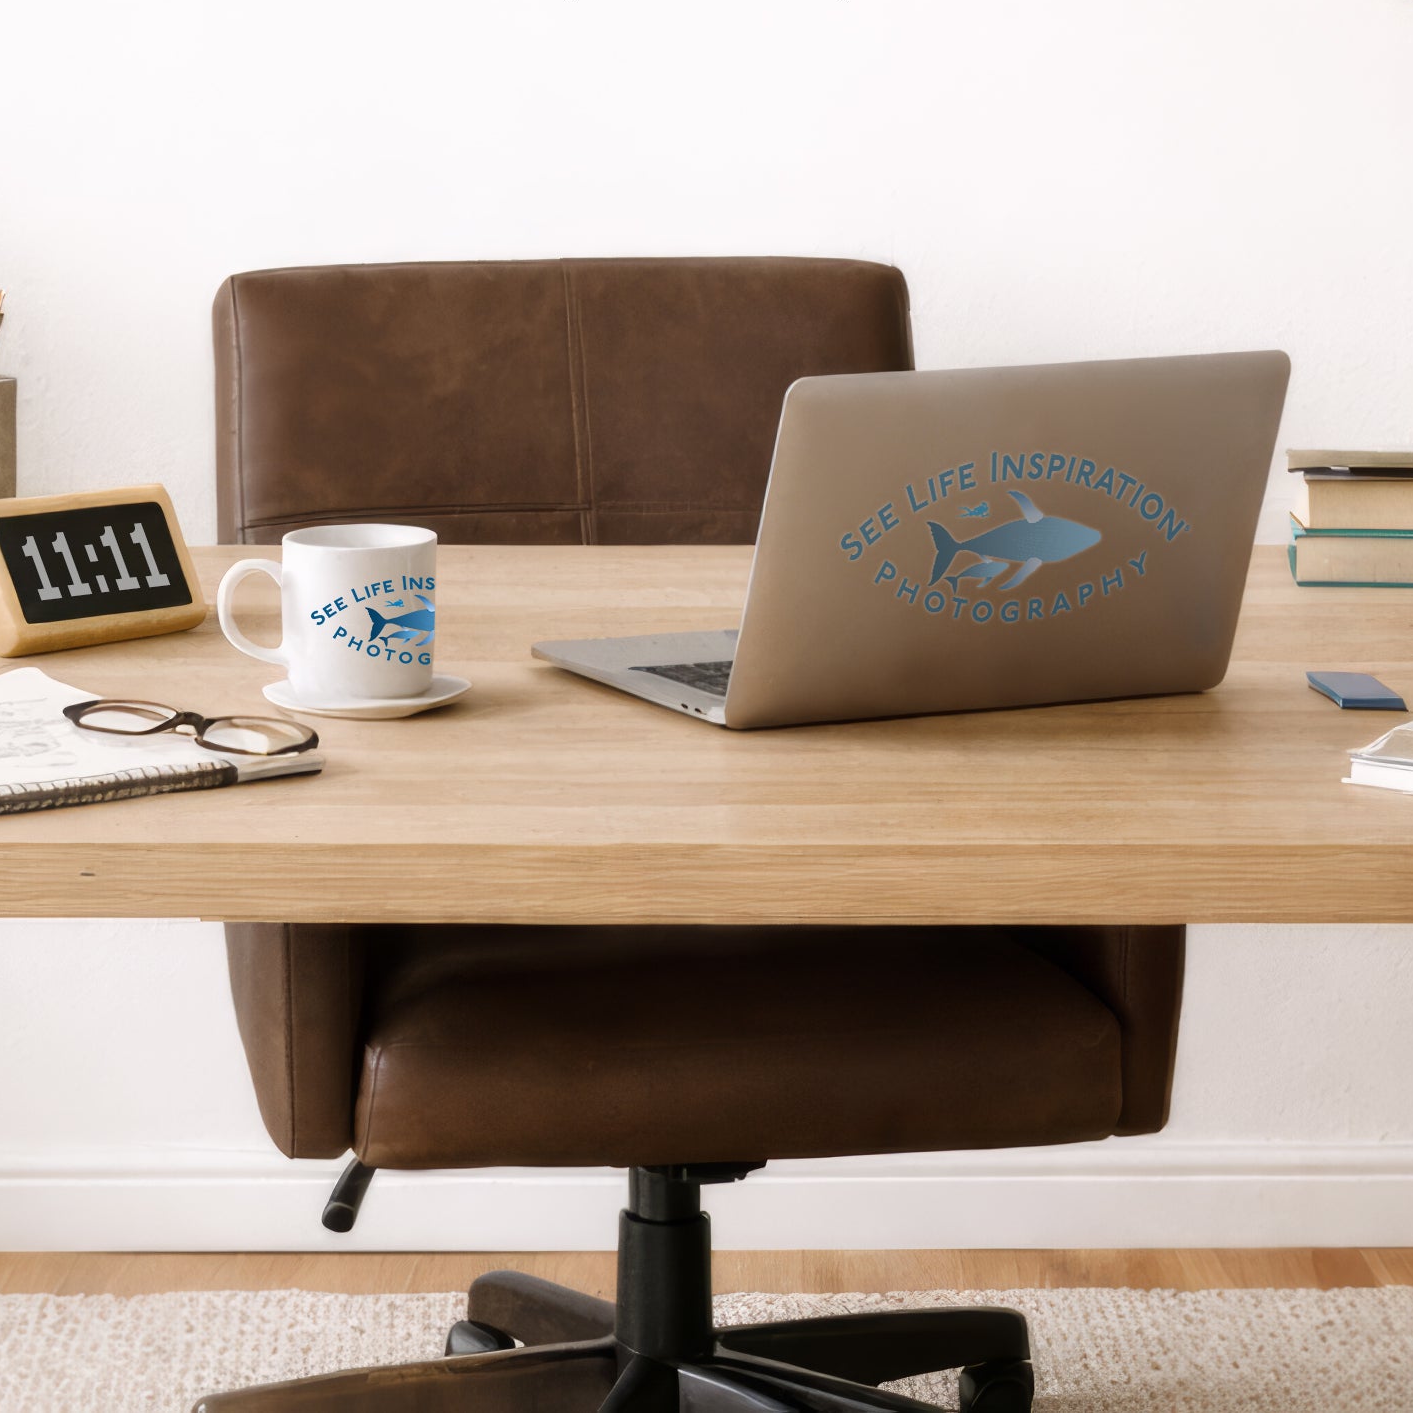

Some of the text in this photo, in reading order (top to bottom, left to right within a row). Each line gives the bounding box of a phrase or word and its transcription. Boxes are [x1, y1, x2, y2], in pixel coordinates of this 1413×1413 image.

[839, 502, 901, 562] SEE
[904, 461, 978, 514] LIFE
[22, 522, 171, 601] 11:11
[873, 550, 1148, 624] PHOTOGRAPHY
[310, 596, 348, 626] SEE
[351, 579, 395, 603] LIFE
